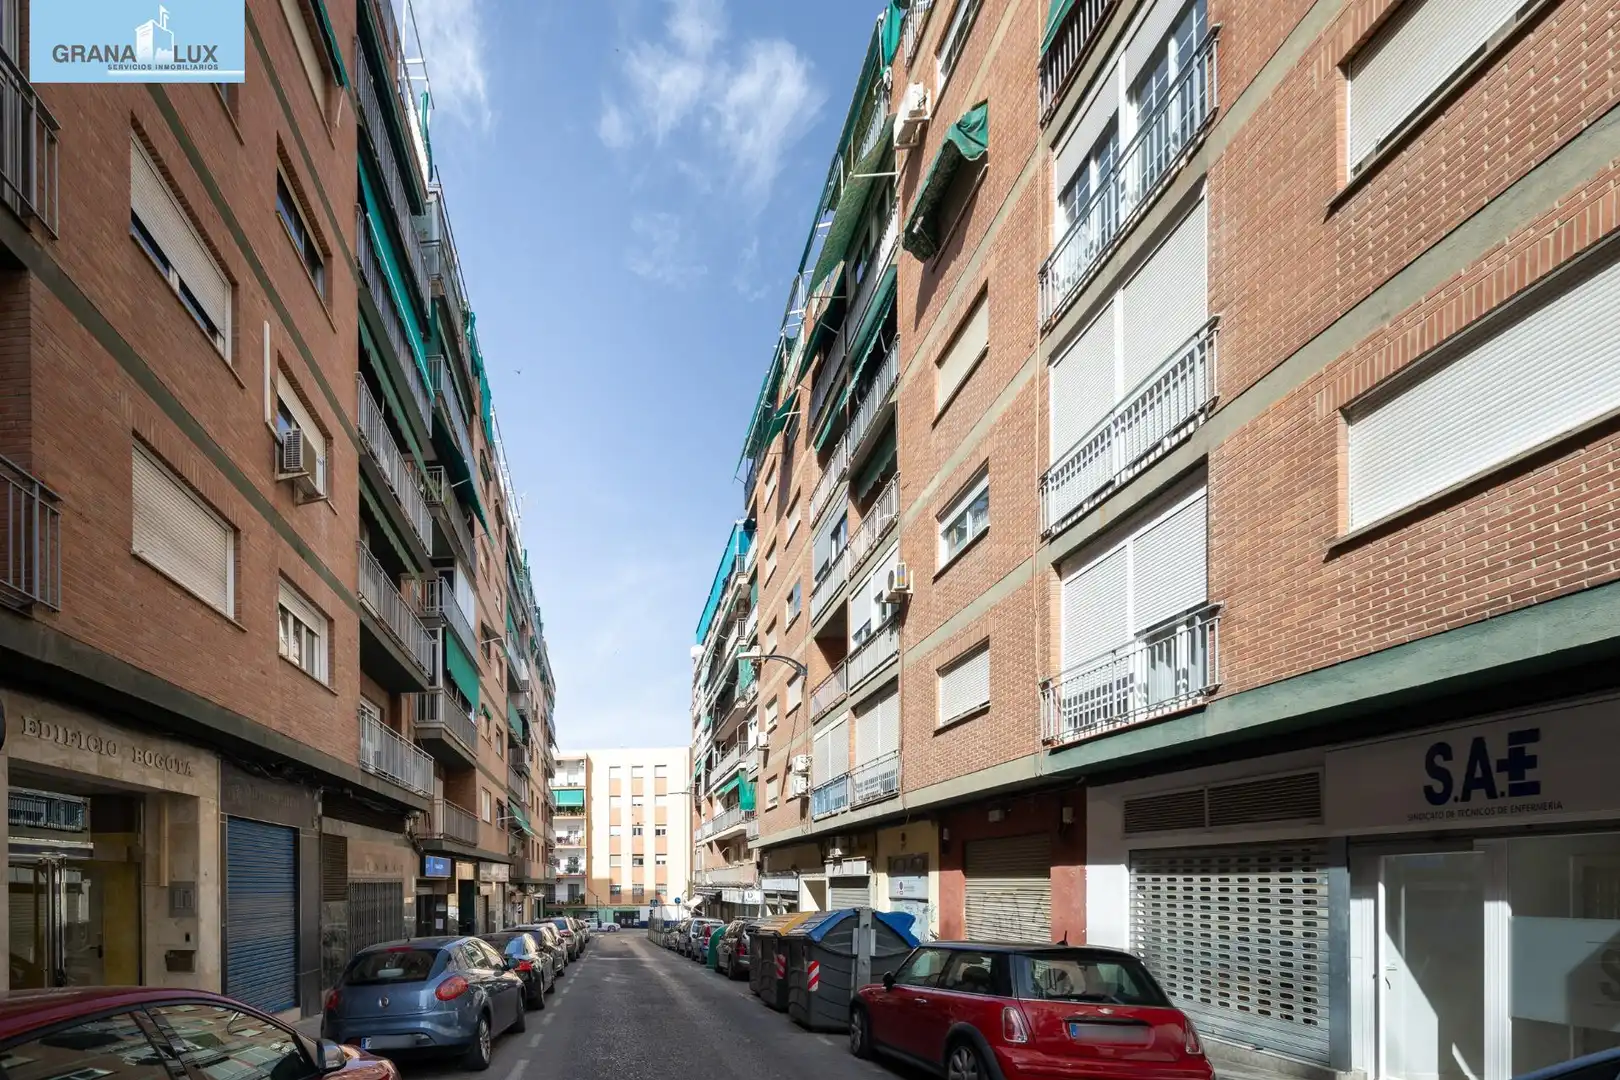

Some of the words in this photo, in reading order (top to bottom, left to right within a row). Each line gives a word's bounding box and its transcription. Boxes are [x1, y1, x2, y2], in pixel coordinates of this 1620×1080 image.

[21, 715, 117, 758] EDIFICIO
[132, 746, 195, 777] BOGOTA
[1407, 810, 1445, 822] SINDICATO
[1446, 809, 1456, 820] DE
[1497, 805, 1508, 816] DE
